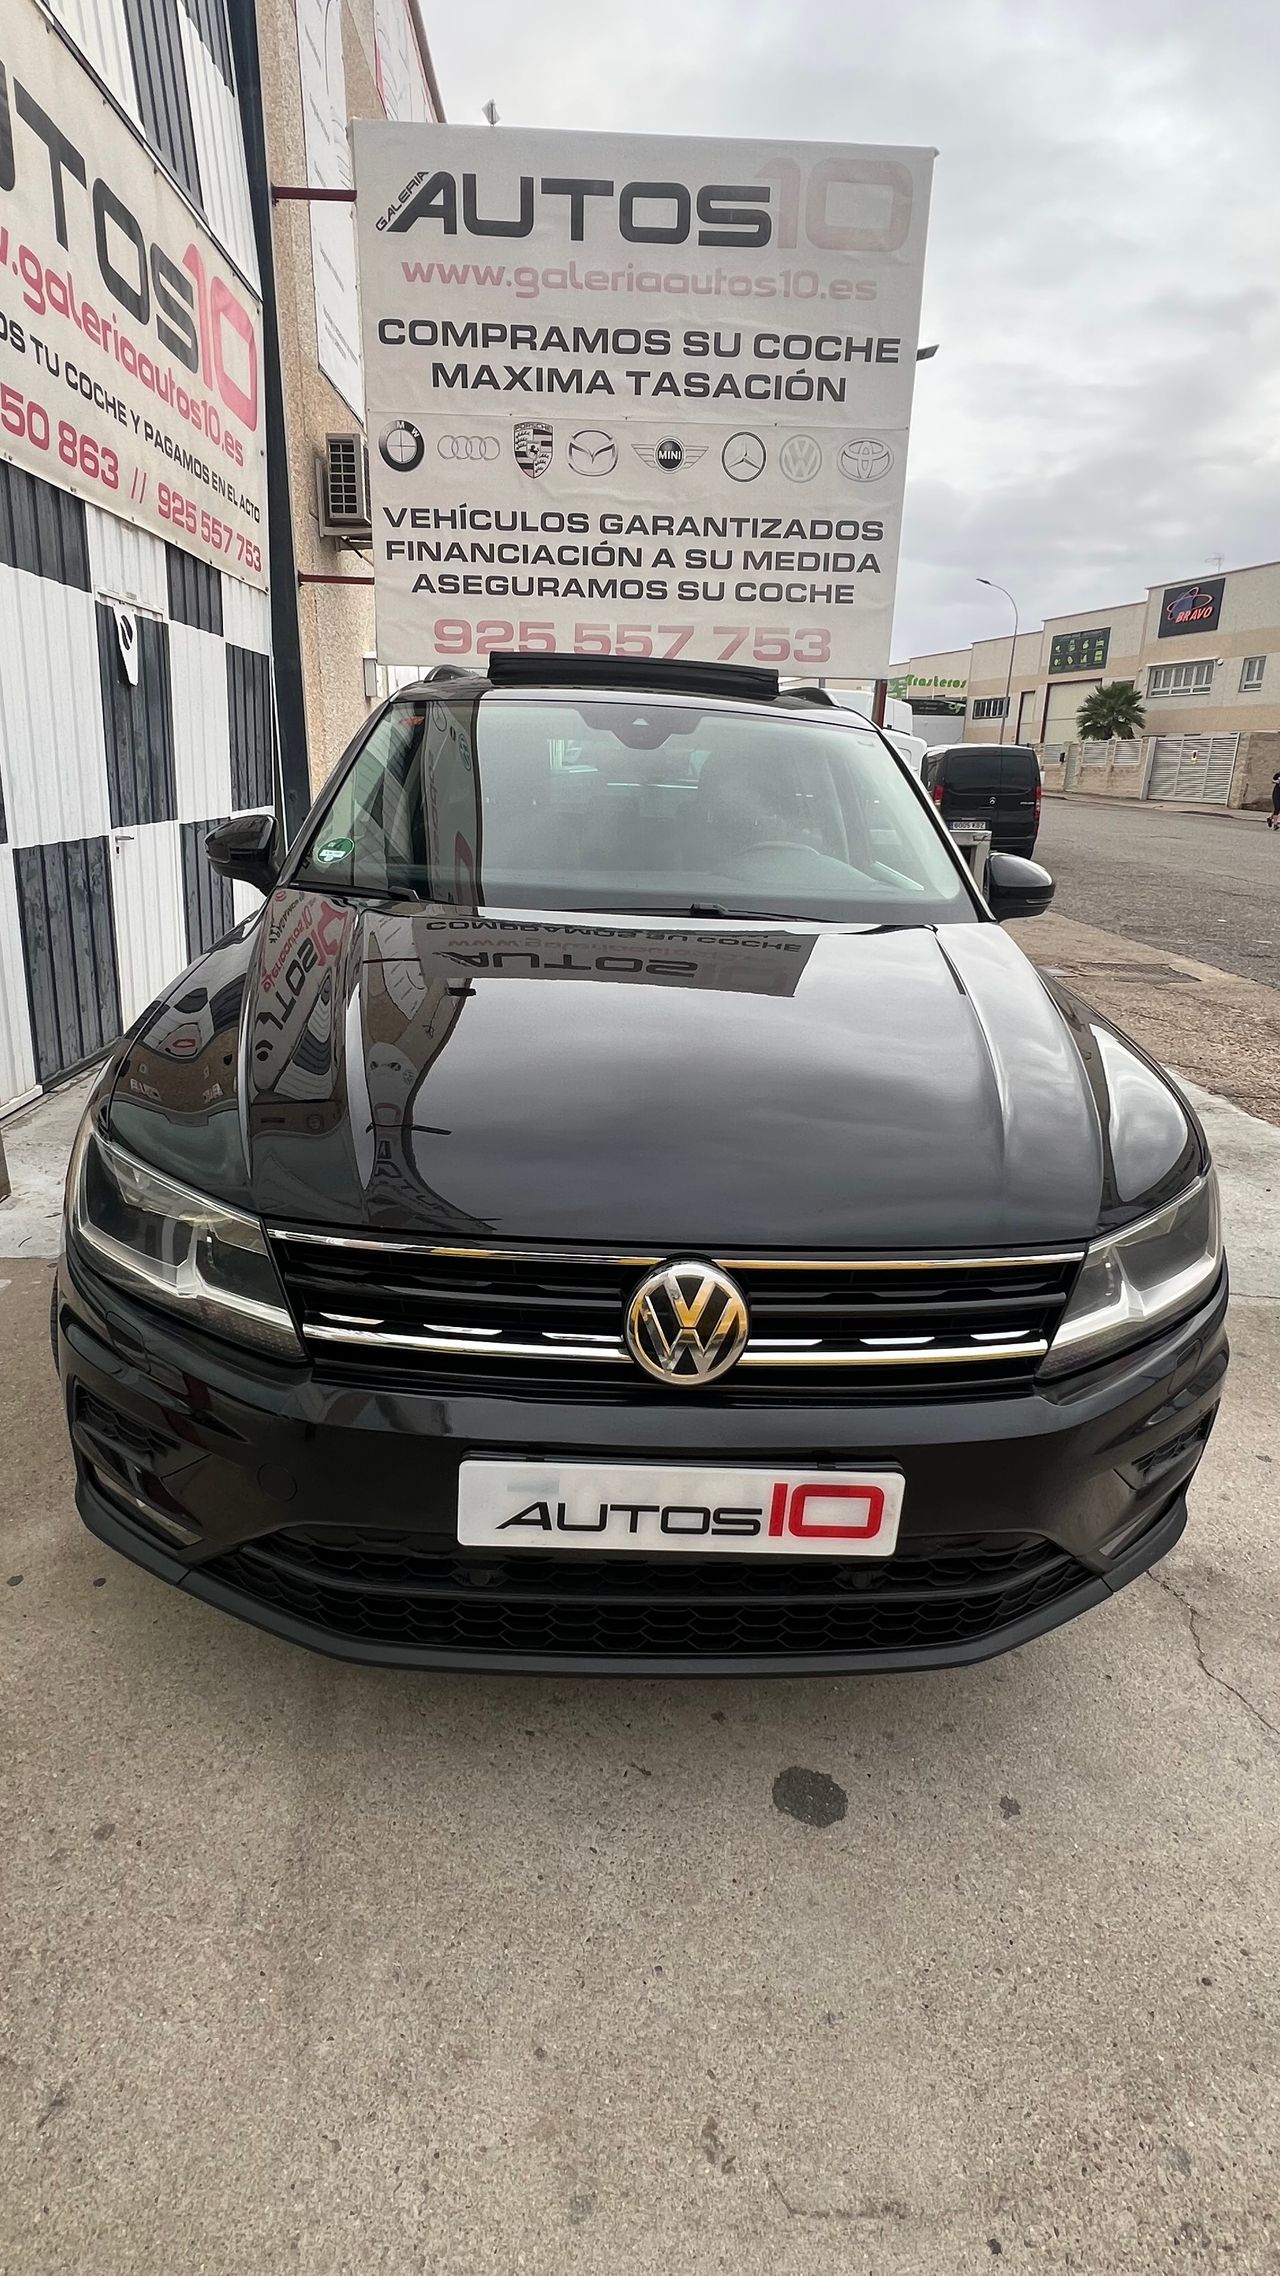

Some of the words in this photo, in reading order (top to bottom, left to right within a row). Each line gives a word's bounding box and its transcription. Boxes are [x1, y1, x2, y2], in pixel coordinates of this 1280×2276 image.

[375, 171, 430, 232] GALERIA
[400, 261, 878, 301] www.galeriaautos10.es
[377, 318, 672, 356] COMPRAMOS
[682, 331, 742, 358] SU
[753, 333, 902, 363] COCHE
[431, 362, 615, 396] MAXIMA
[625, 368, 846, 403] TASACIÓN
[30, 334, 60, 377] TU
[65, 361, 127, 427] COCHE
[130, 408, 140, 434] Y
[144, 420, 210, 485] PAGAMOS
[211, 470, 226, 497] EN
[227, 483, 238, 506] EL
[239, 494, 260, 523] ACTO
[658, 450, 681, 461] MINI
[58, 420, 119, 490] 863
[157, 481, 197, 535] 925
[201, 509, 233, 554] 557
[236, 532, 261, 573] 753
[382, 502, 590, 534] VEHÍCULOS
[599, 512, 884, 542] GARANTIZADOS
[385, 540, 643, 569] FINANCIACIÓN
[651, 547, 676, 569] A
[684, 548, 733, 571] SU
[742, 550, 881, 574] MEDIDA
[411, 573, 668, 600] ASEGURAMOS
[677, 579, 724, 601] SU
[734, 581, 855, 604] COCHE
[1174, 606, 1214, 624] BRAVO
[433, 618, 557, 655] 925
[573, 623, 695, 660] 557
[713, 626, 831, 663] 753
[905, 674, 967, 689] Trasteros
[495, 1482, 885, 1540] AUTOS10
